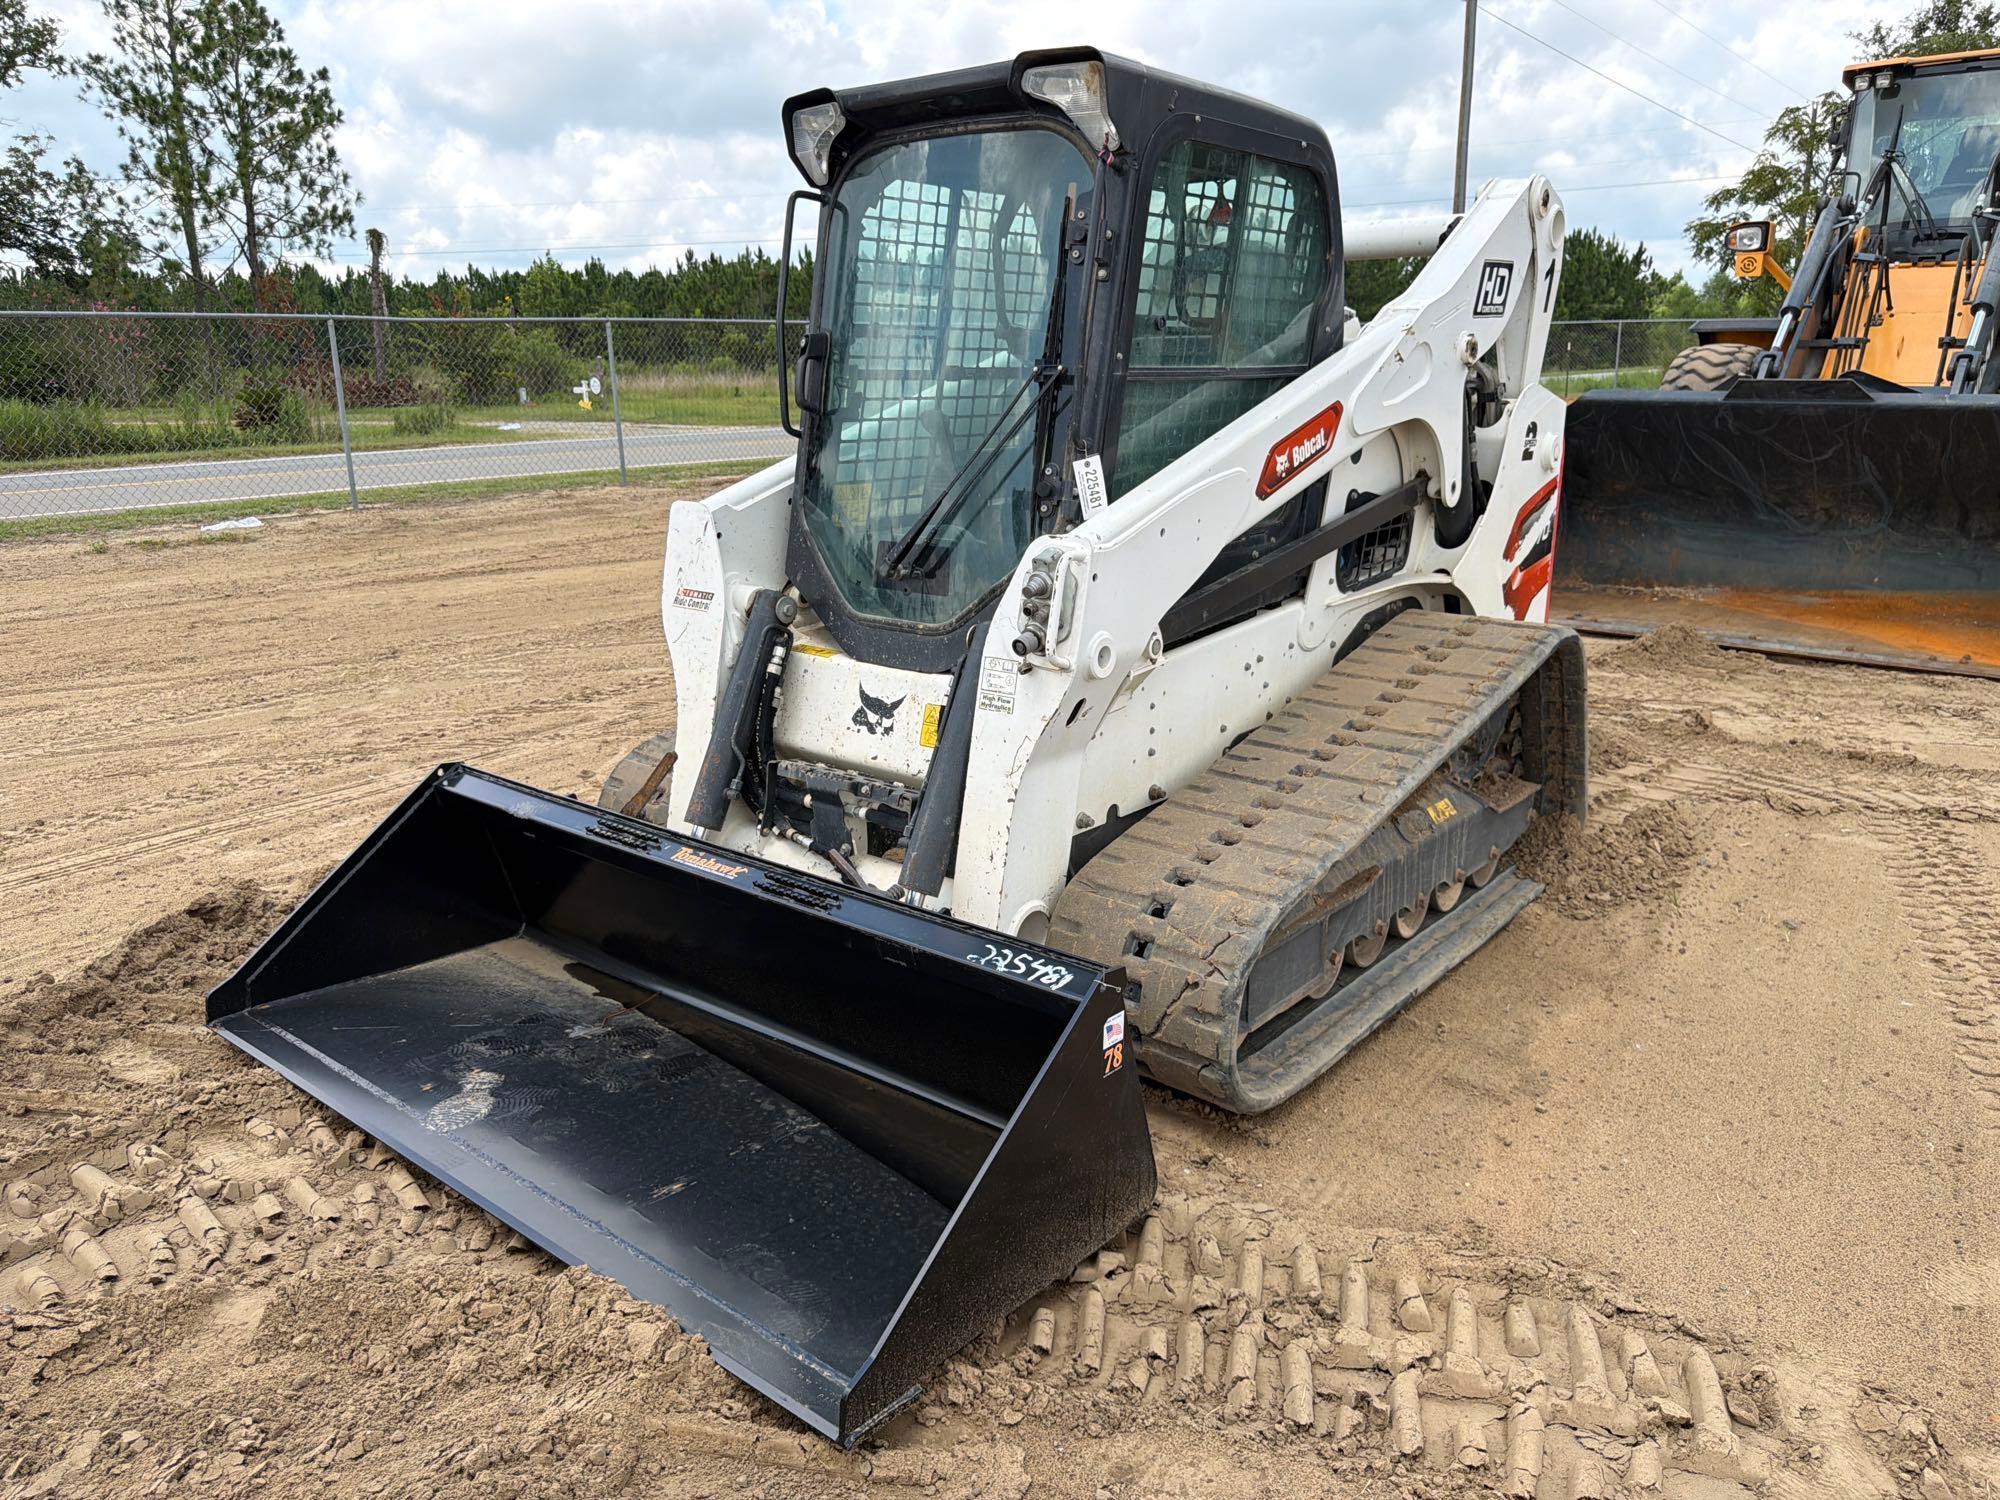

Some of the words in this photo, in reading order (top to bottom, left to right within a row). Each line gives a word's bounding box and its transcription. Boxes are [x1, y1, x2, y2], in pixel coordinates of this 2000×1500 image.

[1476, 266, 1510, 313] HD
[1543, 258, 1556, 313] 1
[1291, 426, 1328, 468] Bobcat
[1521, 421, 1538, 461] 2
[1085, 469, 1103, 509] 225481
[980, 701, 1012, 712] Hydraulics
[982, 695, 996, 703] High
[997, 696, 1012, 705] Flow
[670, 846, 748, 878] Tomahawk
[1104, 1043, 1123, 1075] 78
